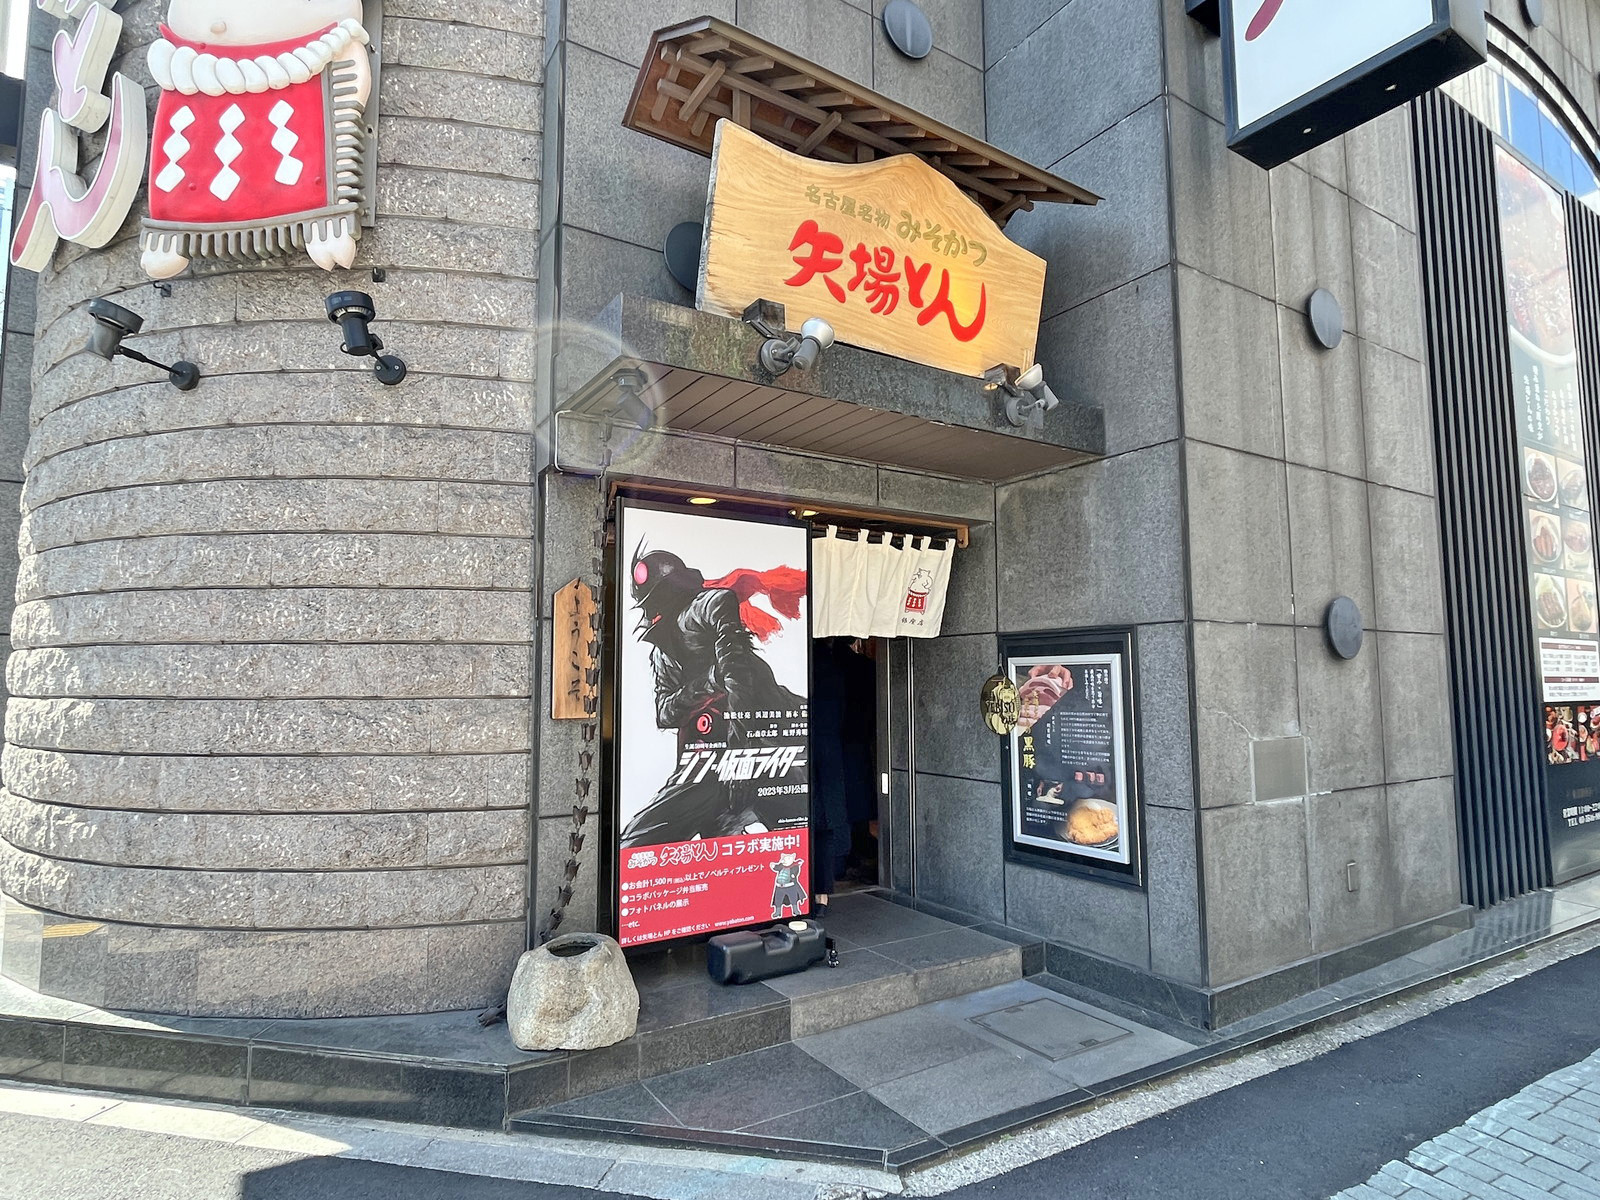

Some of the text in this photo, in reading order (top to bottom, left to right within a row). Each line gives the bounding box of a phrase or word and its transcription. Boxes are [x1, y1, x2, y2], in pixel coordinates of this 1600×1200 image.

[804, 182, 988, 267] 名古屋名物 みそかつ
[783, 218, 986, 342] 矢場とん
[757, 784, 809, 797] 2023年3月公開
[660, 841, 719, 867] 矢場とん
[722, 834, 801, 857] コラボ実施中!
[629, 883, 709, 902] コラボパッケージ弁当販売
[628, 898, 690, 916] フォトパネルの展示
